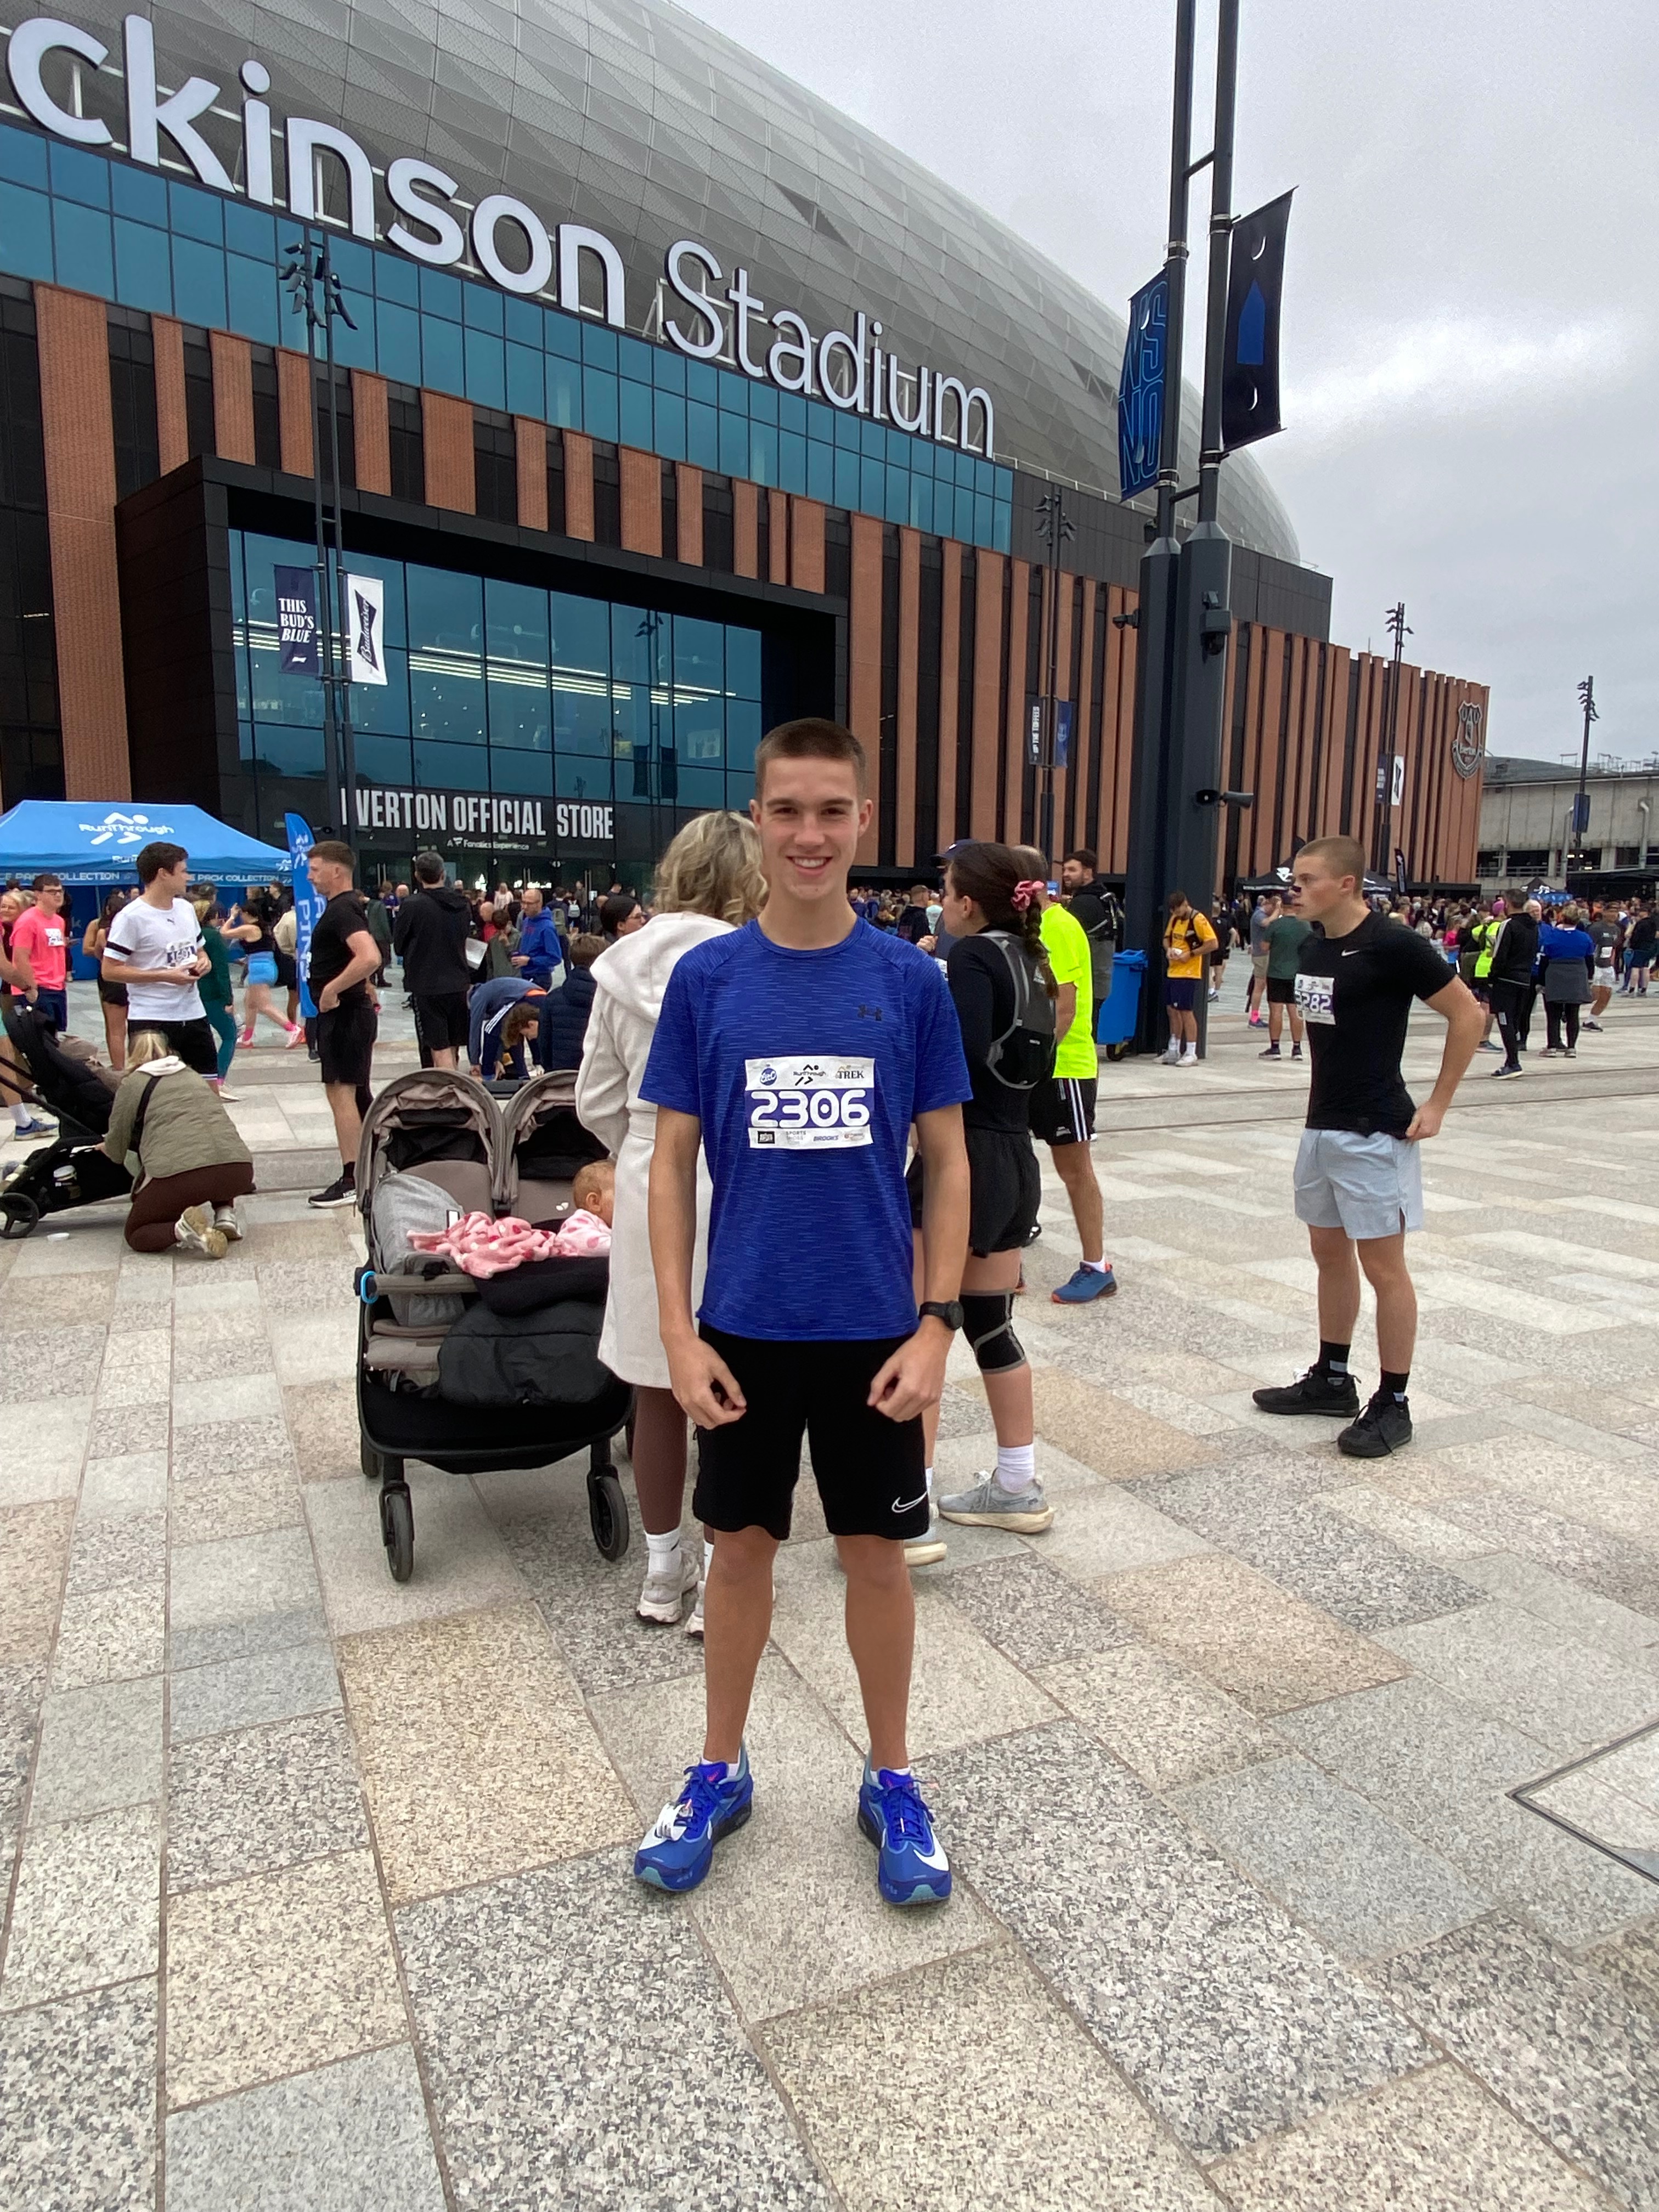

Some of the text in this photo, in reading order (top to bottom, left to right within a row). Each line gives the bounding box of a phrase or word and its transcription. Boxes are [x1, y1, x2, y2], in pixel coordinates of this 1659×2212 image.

[7, 14, 994, 459] ckinson Stadium
[279, 598, 307, 613] THIS
[280, 613, 314, 629] BUD'S
[281, 629, 312, 643] BLUE
[360, 599, 373, 662] Budweiser
[453, 796, 546, 836] OFFICIAL
[556, 803, 614, 839] STORE
[78, 823, 175, 836] RunThrough
[463, 839, 492, 849] Fanatics
[493, 841, 529, 850] Experience
[198, 874, 224, 882] PACK
[225, 874, 279, 882] COLLECTION
[838, 1070, 864, 1079] TREK
[751, 1089, 870, 1128] 2306
